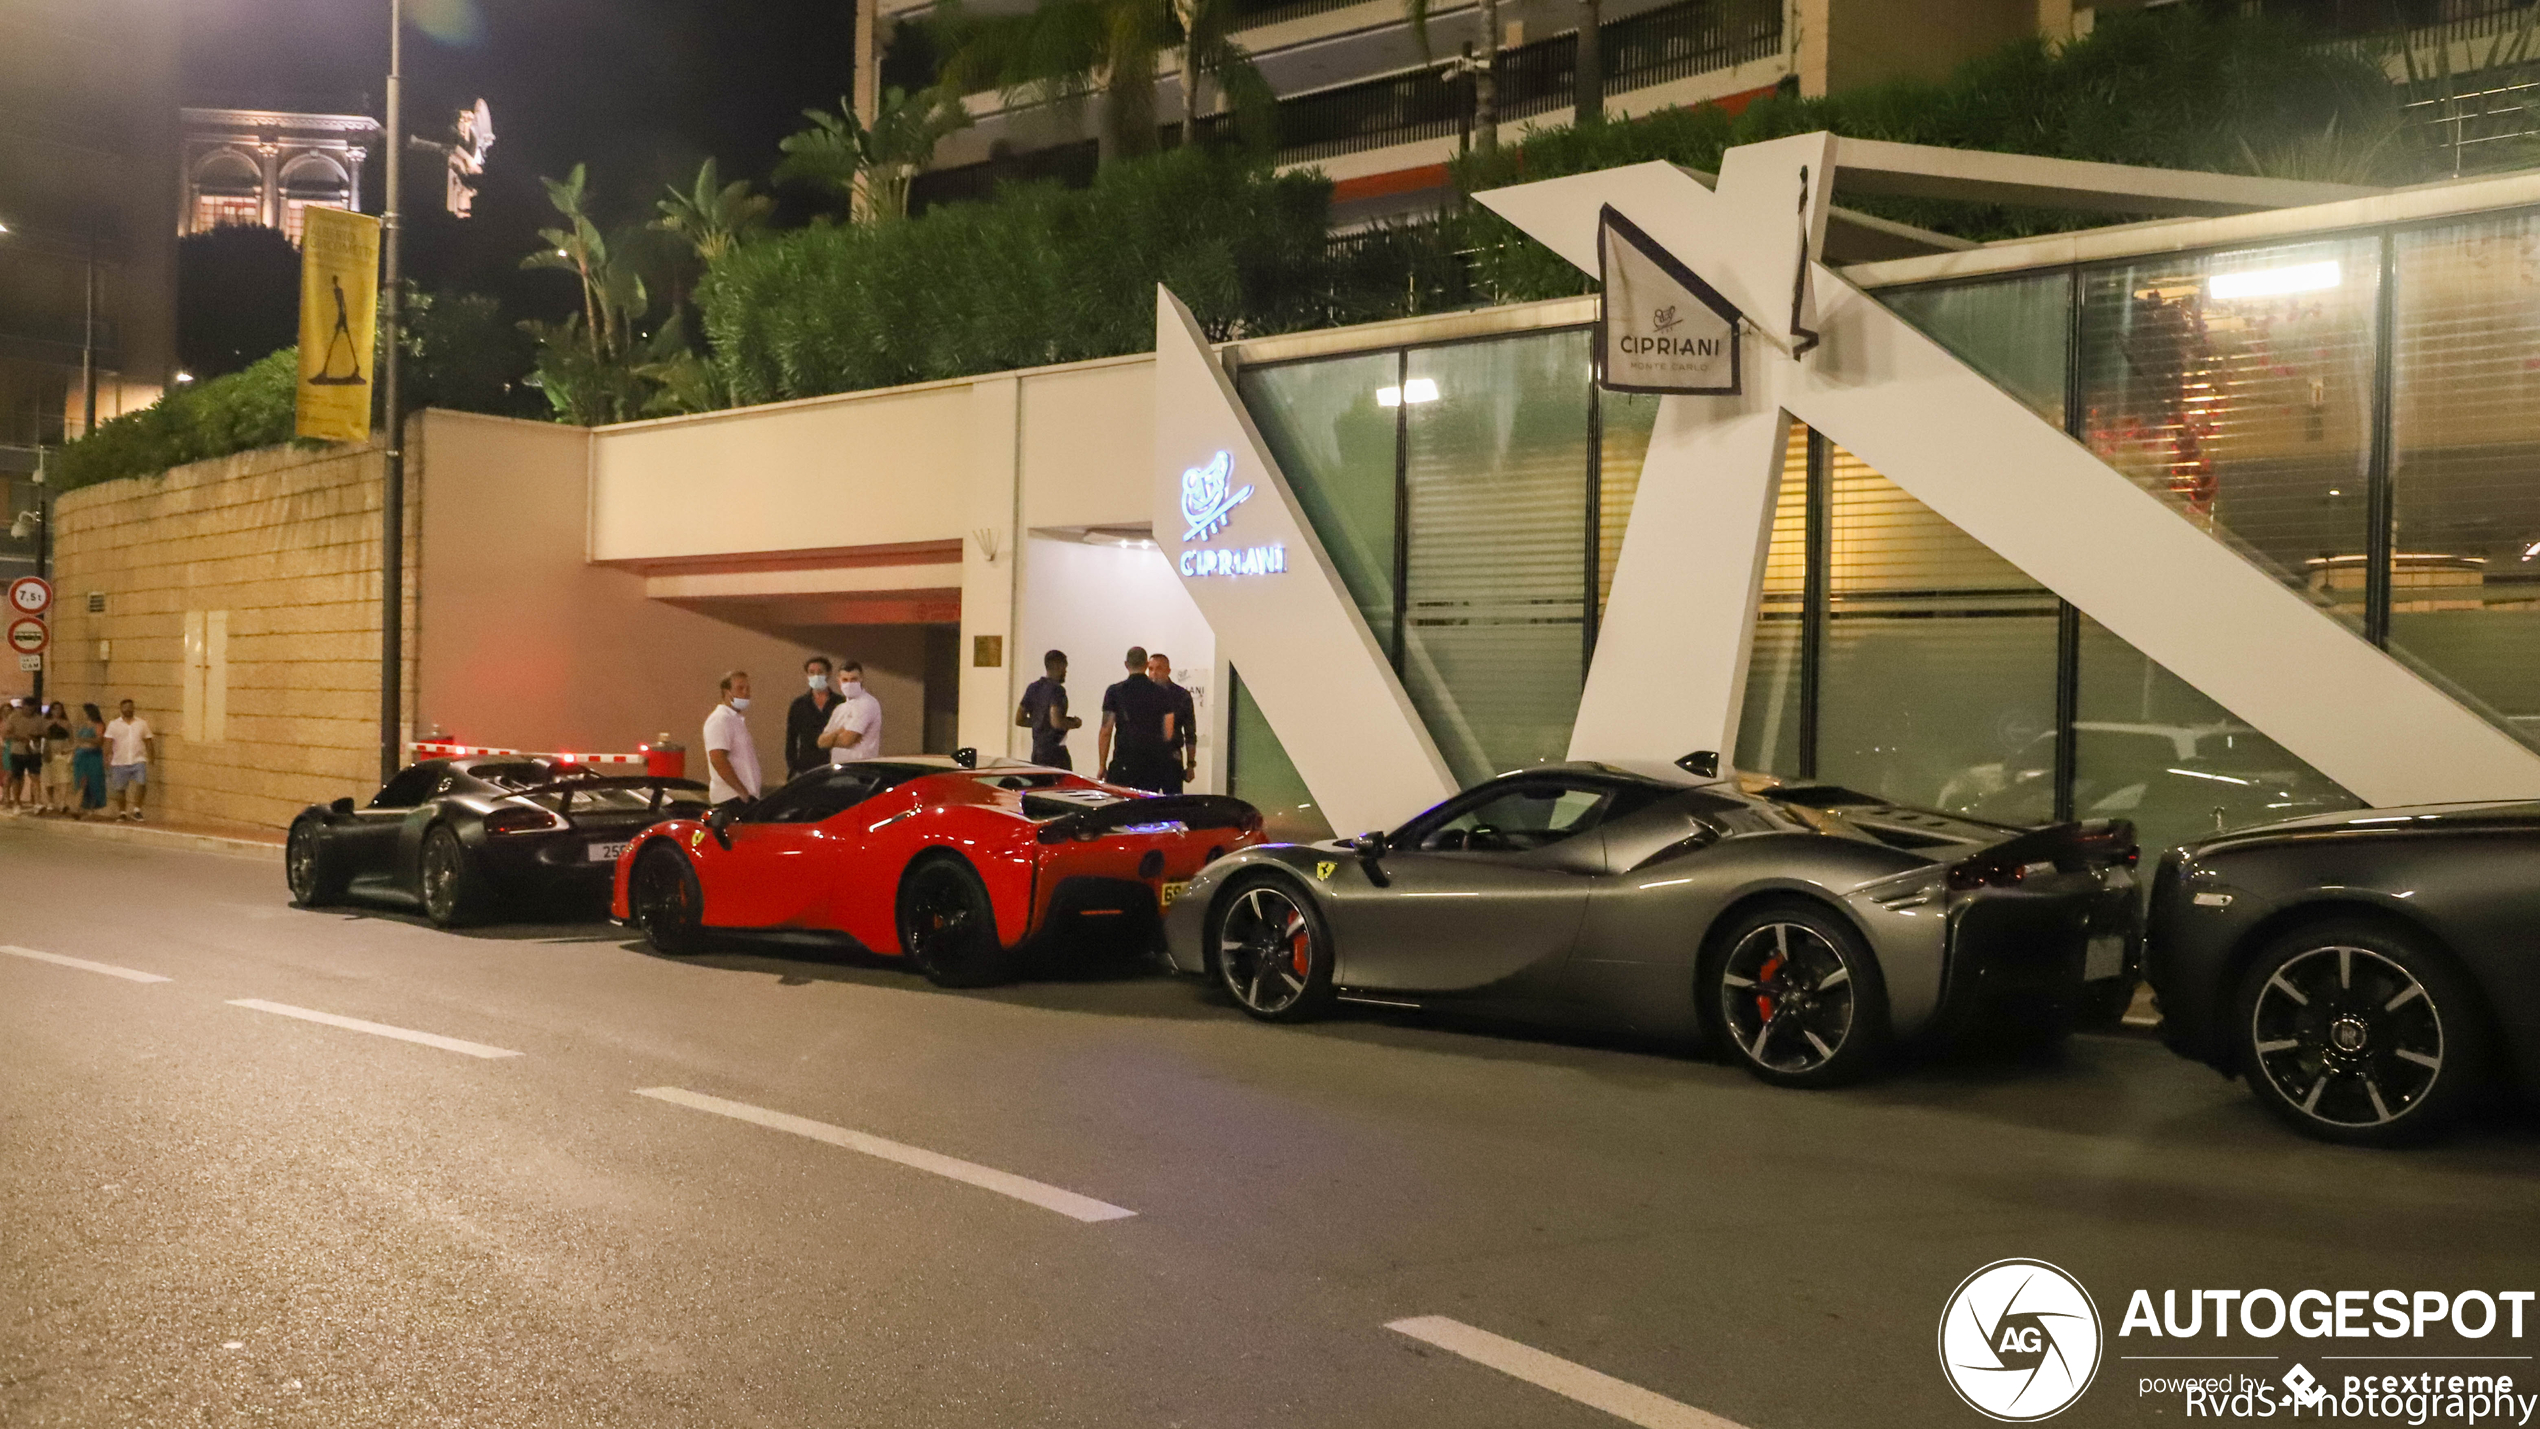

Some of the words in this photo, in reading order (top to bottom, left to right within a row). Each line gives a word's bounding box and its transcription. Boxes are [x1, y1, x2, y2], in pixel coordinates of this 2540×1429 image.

[1620, 336, 1719, 357] CIPRIANI
[1630, 362, 1667, 370] MONTE
[1671, 362, 1708, 371] CARLO
[1180, 546, 1286, 577] CIPRIANI
